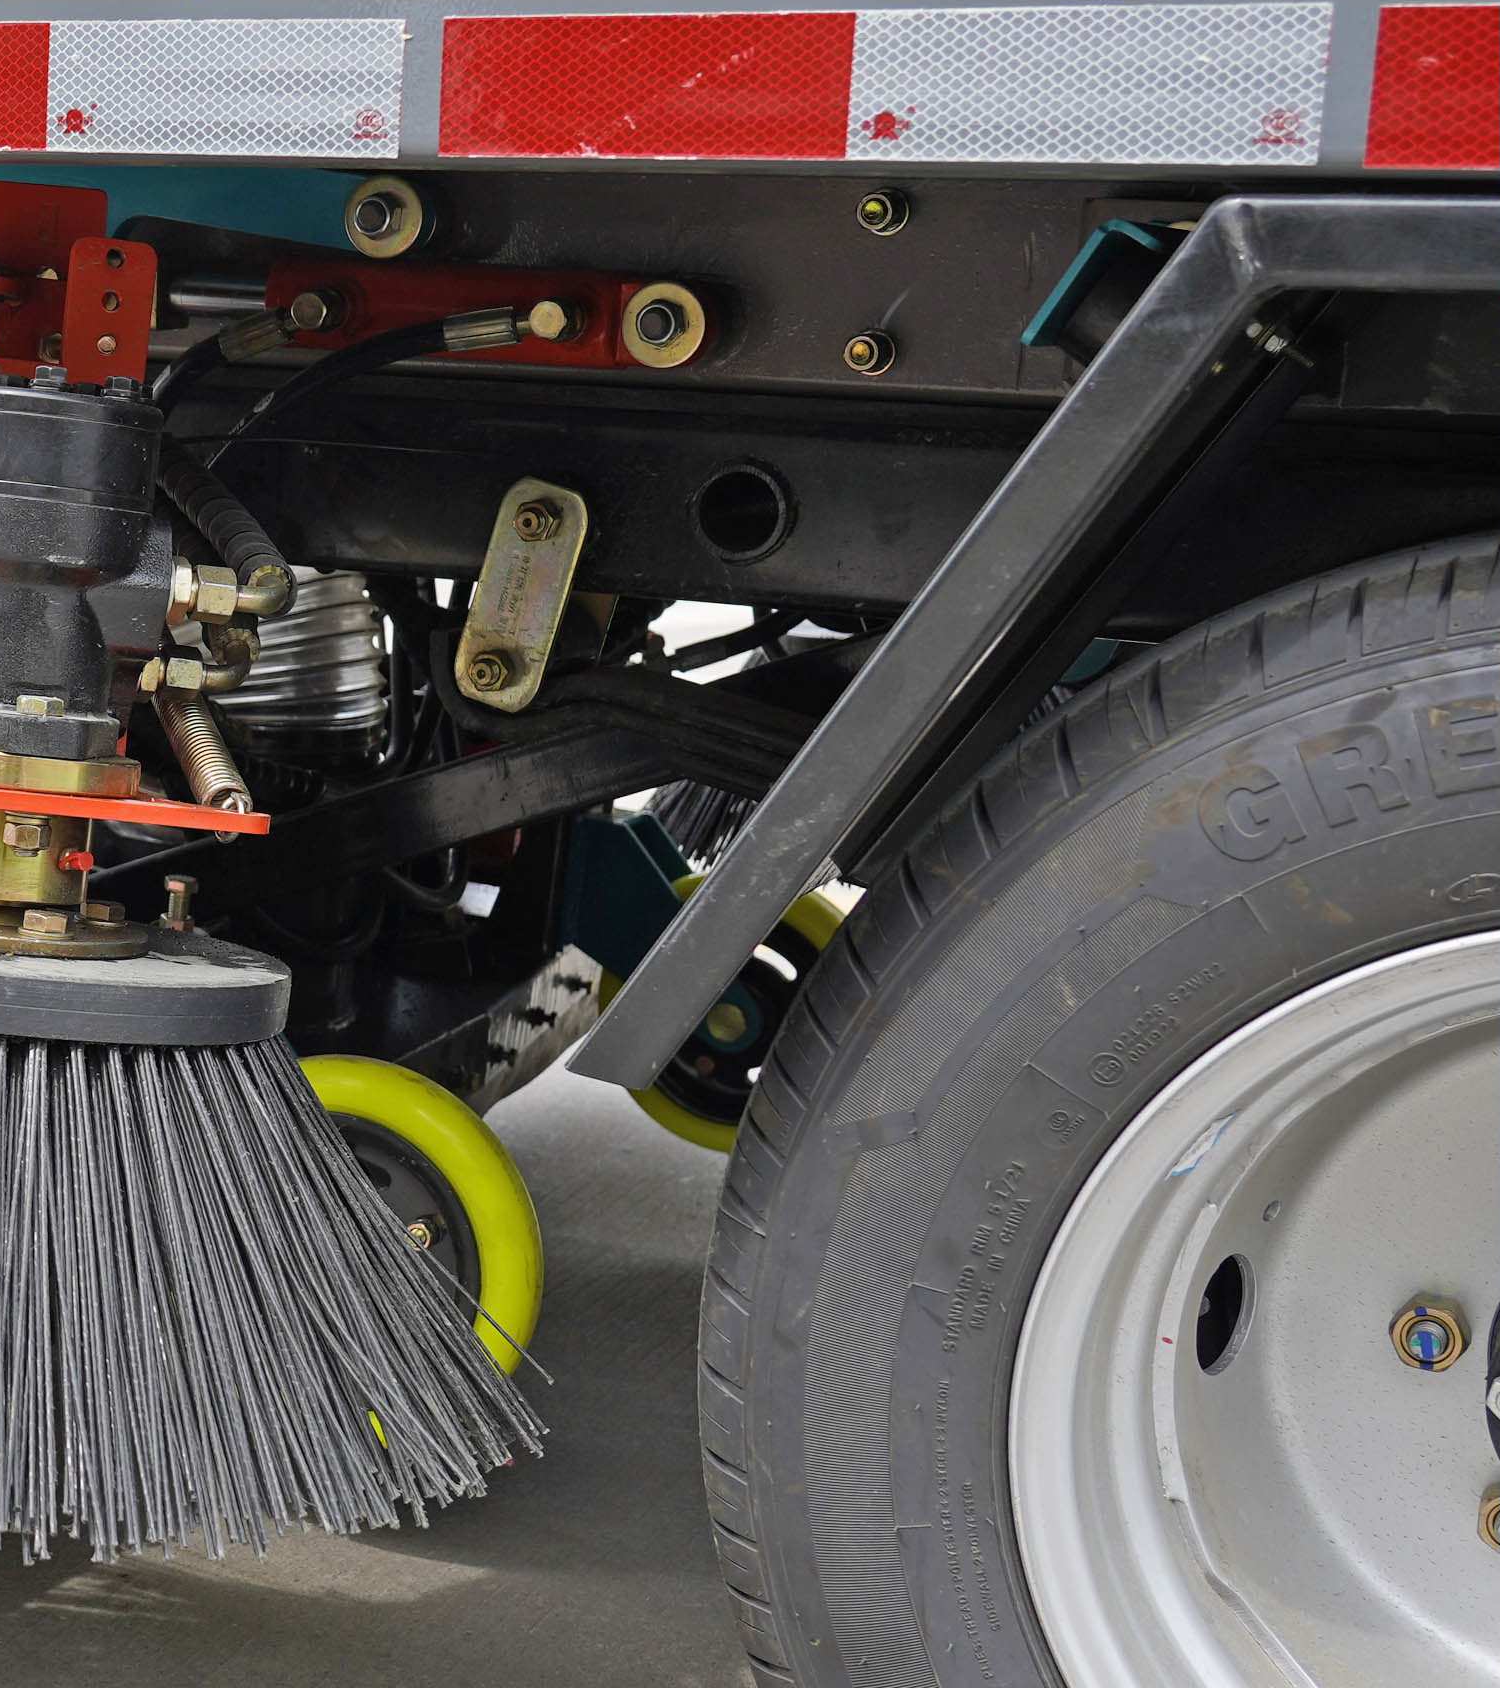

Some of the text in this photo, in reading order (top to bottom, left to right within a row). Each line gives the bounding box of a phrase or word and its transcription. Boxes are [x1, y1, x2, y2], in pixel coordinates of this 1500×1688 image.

[969, 1280, 995, 1331] MADE
[987, 1254, 1005, 1272] IN
[999, 1197, 1031, 1245] CHINA
[970, 1224, 993, 1256] RIM
